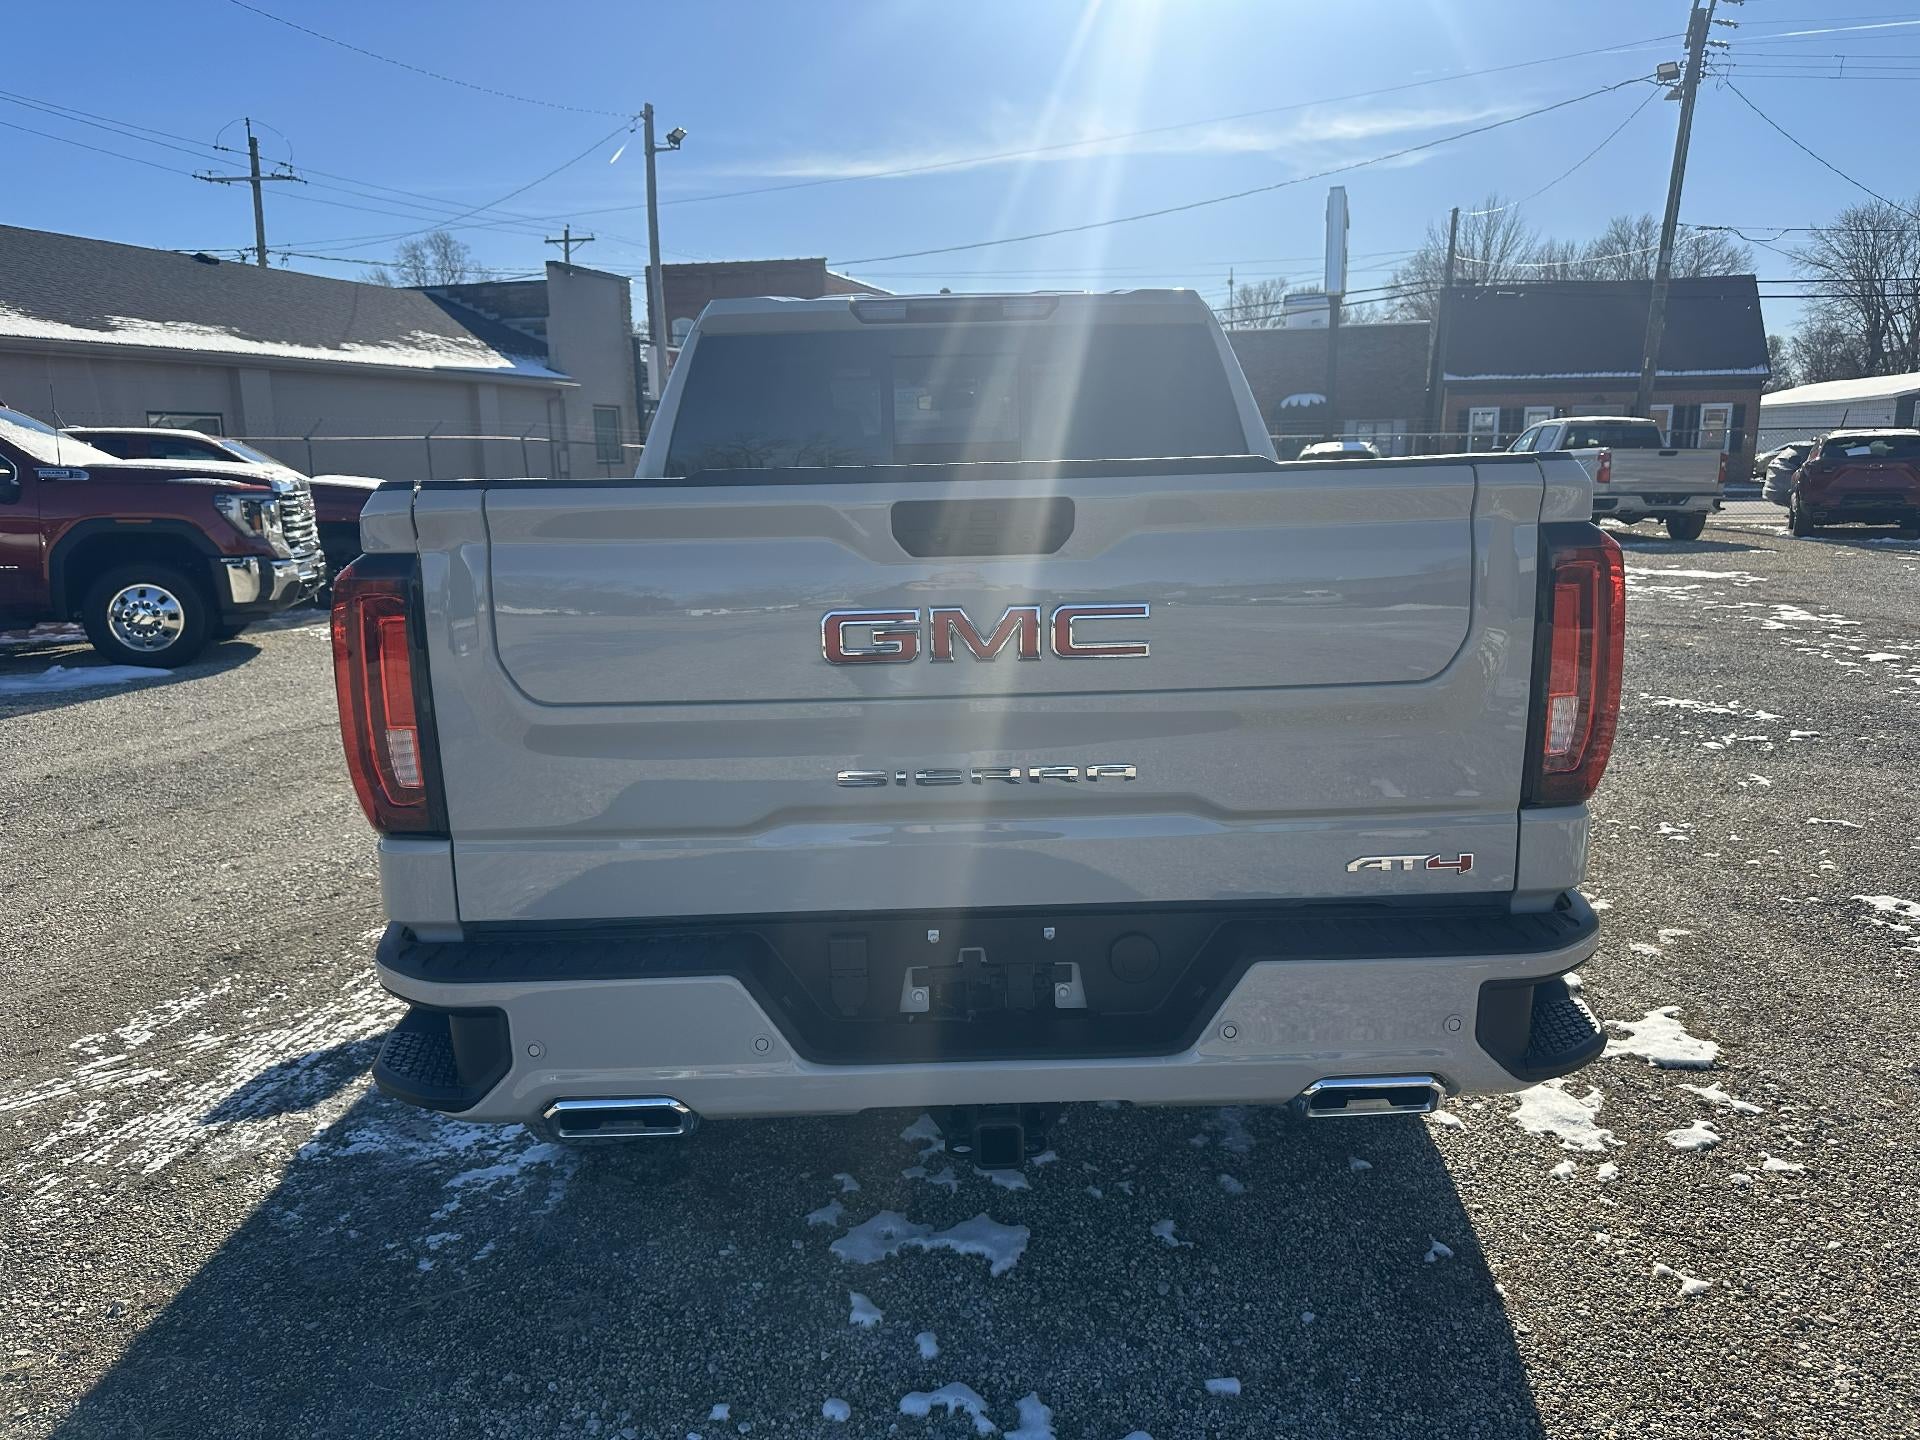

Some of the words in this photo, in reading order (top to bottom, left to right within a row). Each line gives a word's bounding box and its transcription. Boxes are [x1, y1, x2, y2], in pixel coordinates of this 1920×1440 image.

[821, 602, 1150, 664] GMC
[836, 763, 1137, 787] SIERRA
[1346, 853, 1474, 874] AT4
